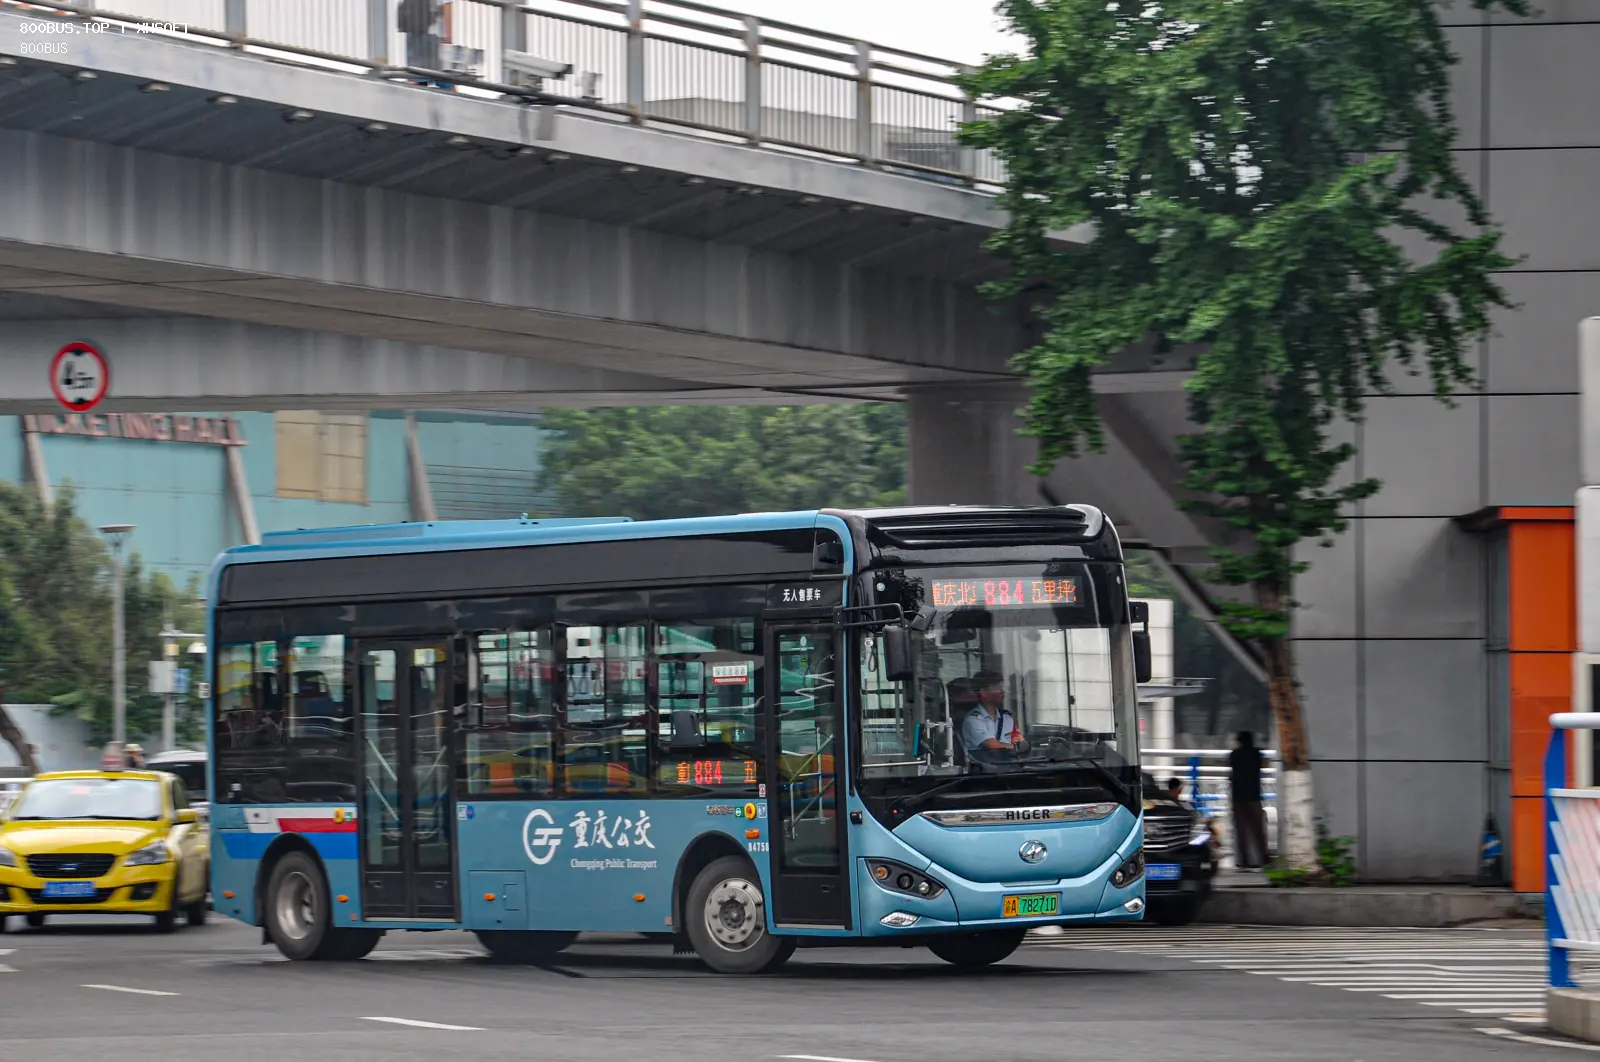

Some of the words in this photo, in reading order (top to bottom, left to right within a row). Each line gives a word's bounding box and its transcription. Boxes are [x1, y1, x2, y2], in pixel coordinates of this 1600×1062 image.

[782, 587, 821, 602] 无人售票车
[984, 579, 1025, 606] 884
[694, 760, 723, 785] 884
[1006, 809, 1051, 821] HIGER
[568, 809, 656, 849] 重庆公交
[570, 858, 605, 871] Chongqing
[605, 858, 625, 868] Public
[626, 858, 658, 871] Transport
